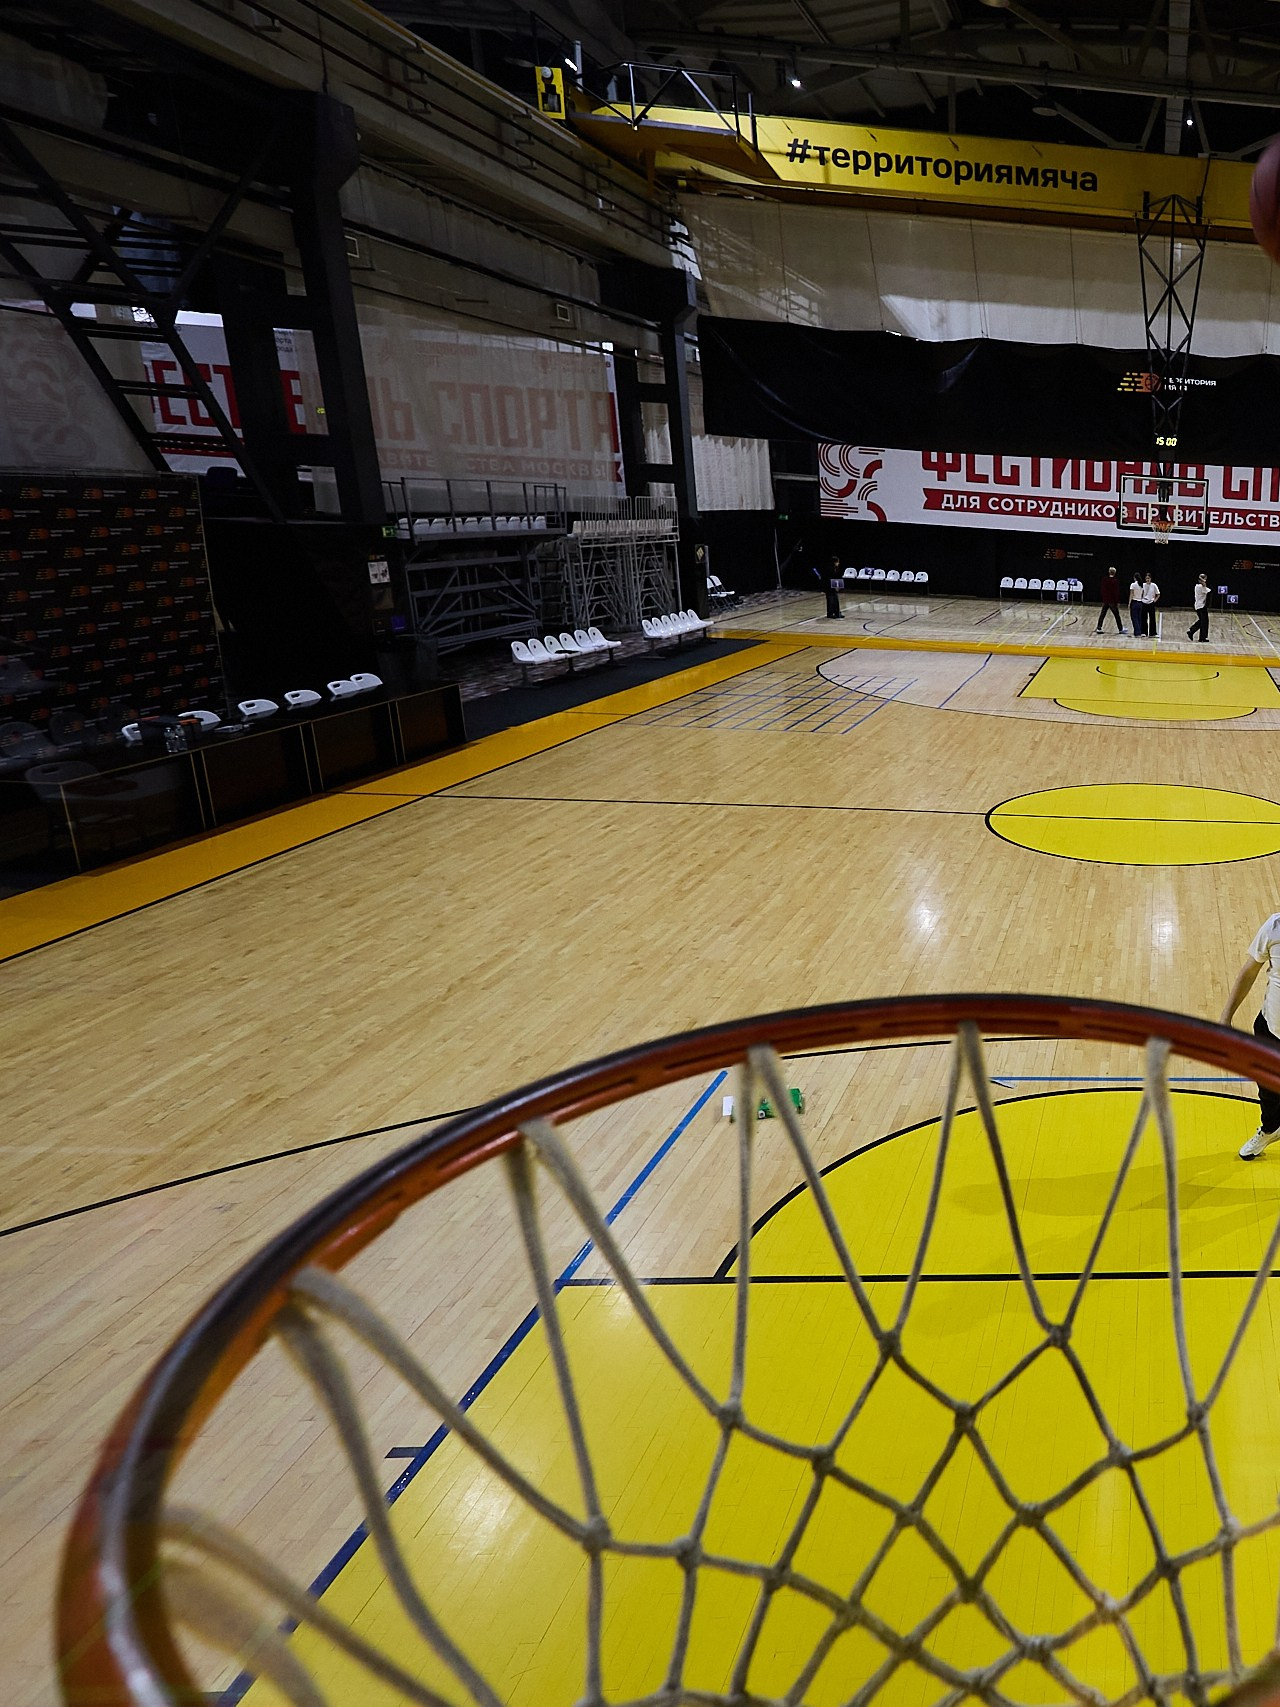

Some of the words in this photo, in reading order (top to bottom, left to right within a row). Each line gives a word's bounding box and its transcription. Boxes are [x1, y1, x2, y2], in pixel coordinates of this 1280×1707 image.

[785, 138, 1098, 193] #территориямяча
[940, 492, 981, 511] ДЛЯ
[987, 496, 1129, 520] СОТРУДНИКОВ
